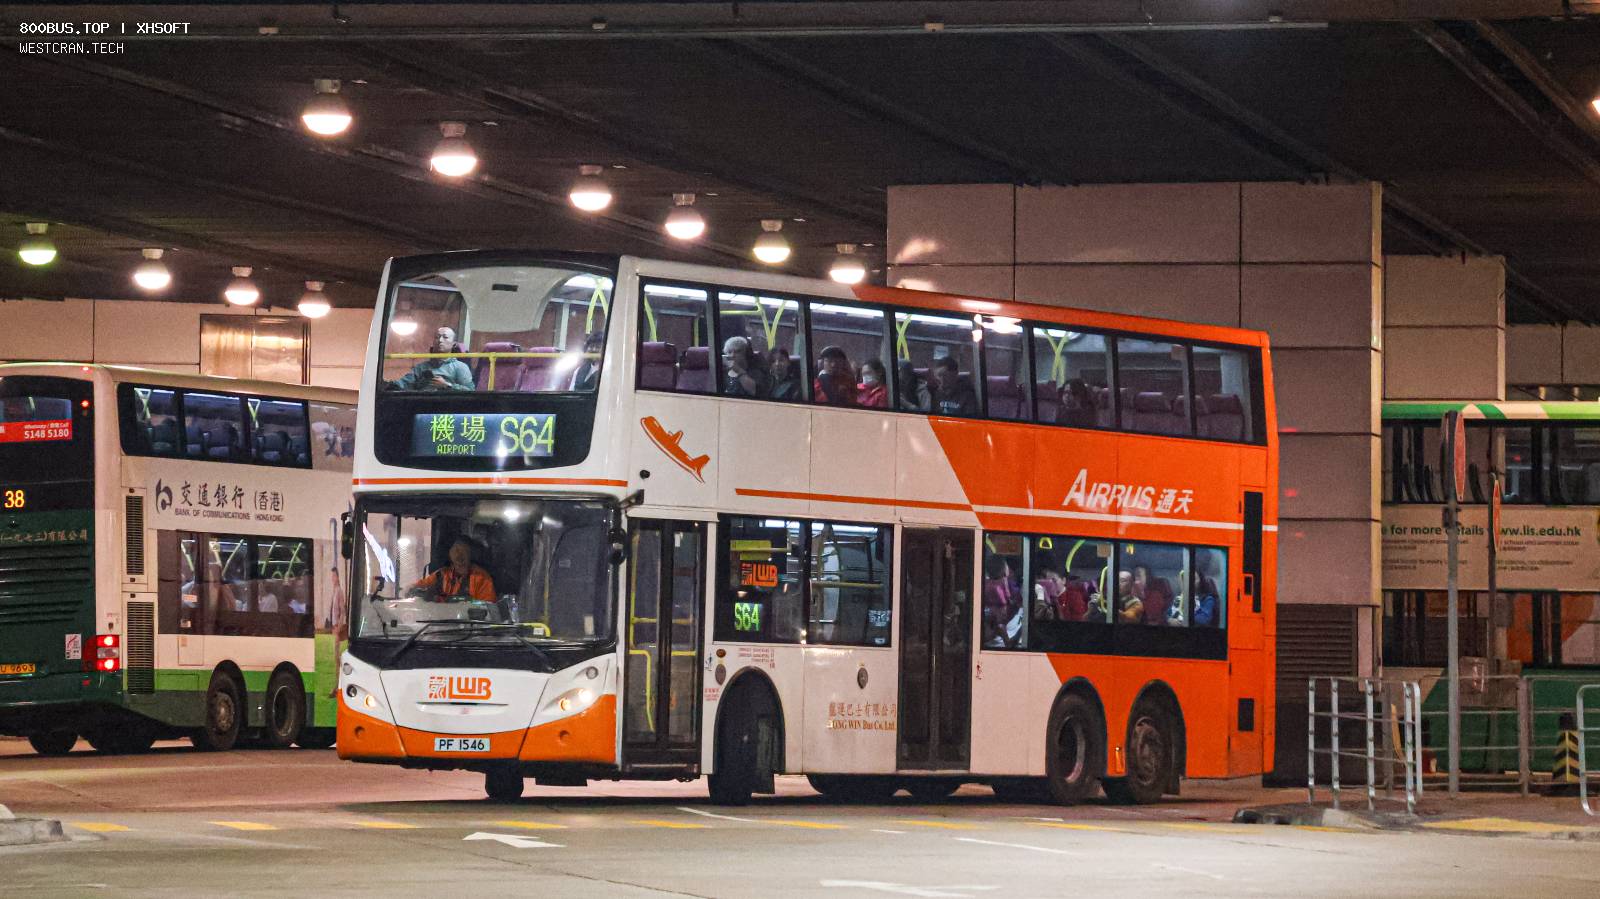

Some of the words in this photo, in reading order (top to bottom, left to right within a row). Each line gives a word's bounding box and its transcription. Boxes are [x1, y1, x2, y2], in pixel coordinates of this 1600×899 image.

[47, 429, 69, 437] 5180
[430, 414, 485, 442] 機場
[500, 415, 555, 454] S64
[436, 444, 476, 456] AIRPORT
[4, 489, 25, 508] 38
[180, 480, 245, 509] 交通銀行
[254, 489, 284, 512] (香港)
[175, 508, 190, 516] BANK
[202, 510, 250, 520] COMMUNICATIONS
[1391, 524, 1409, 536] for
[1411, 526, 1441, 536] more
[753, 564, 778, 587] LWB
[734, 602, 760, 631] S64
[449, 676, 492, 700] LWB
[848, 719, 861, 730] WIN
[439, 739, 454, 750] PF
[459, 739, 485, 750] 1546
